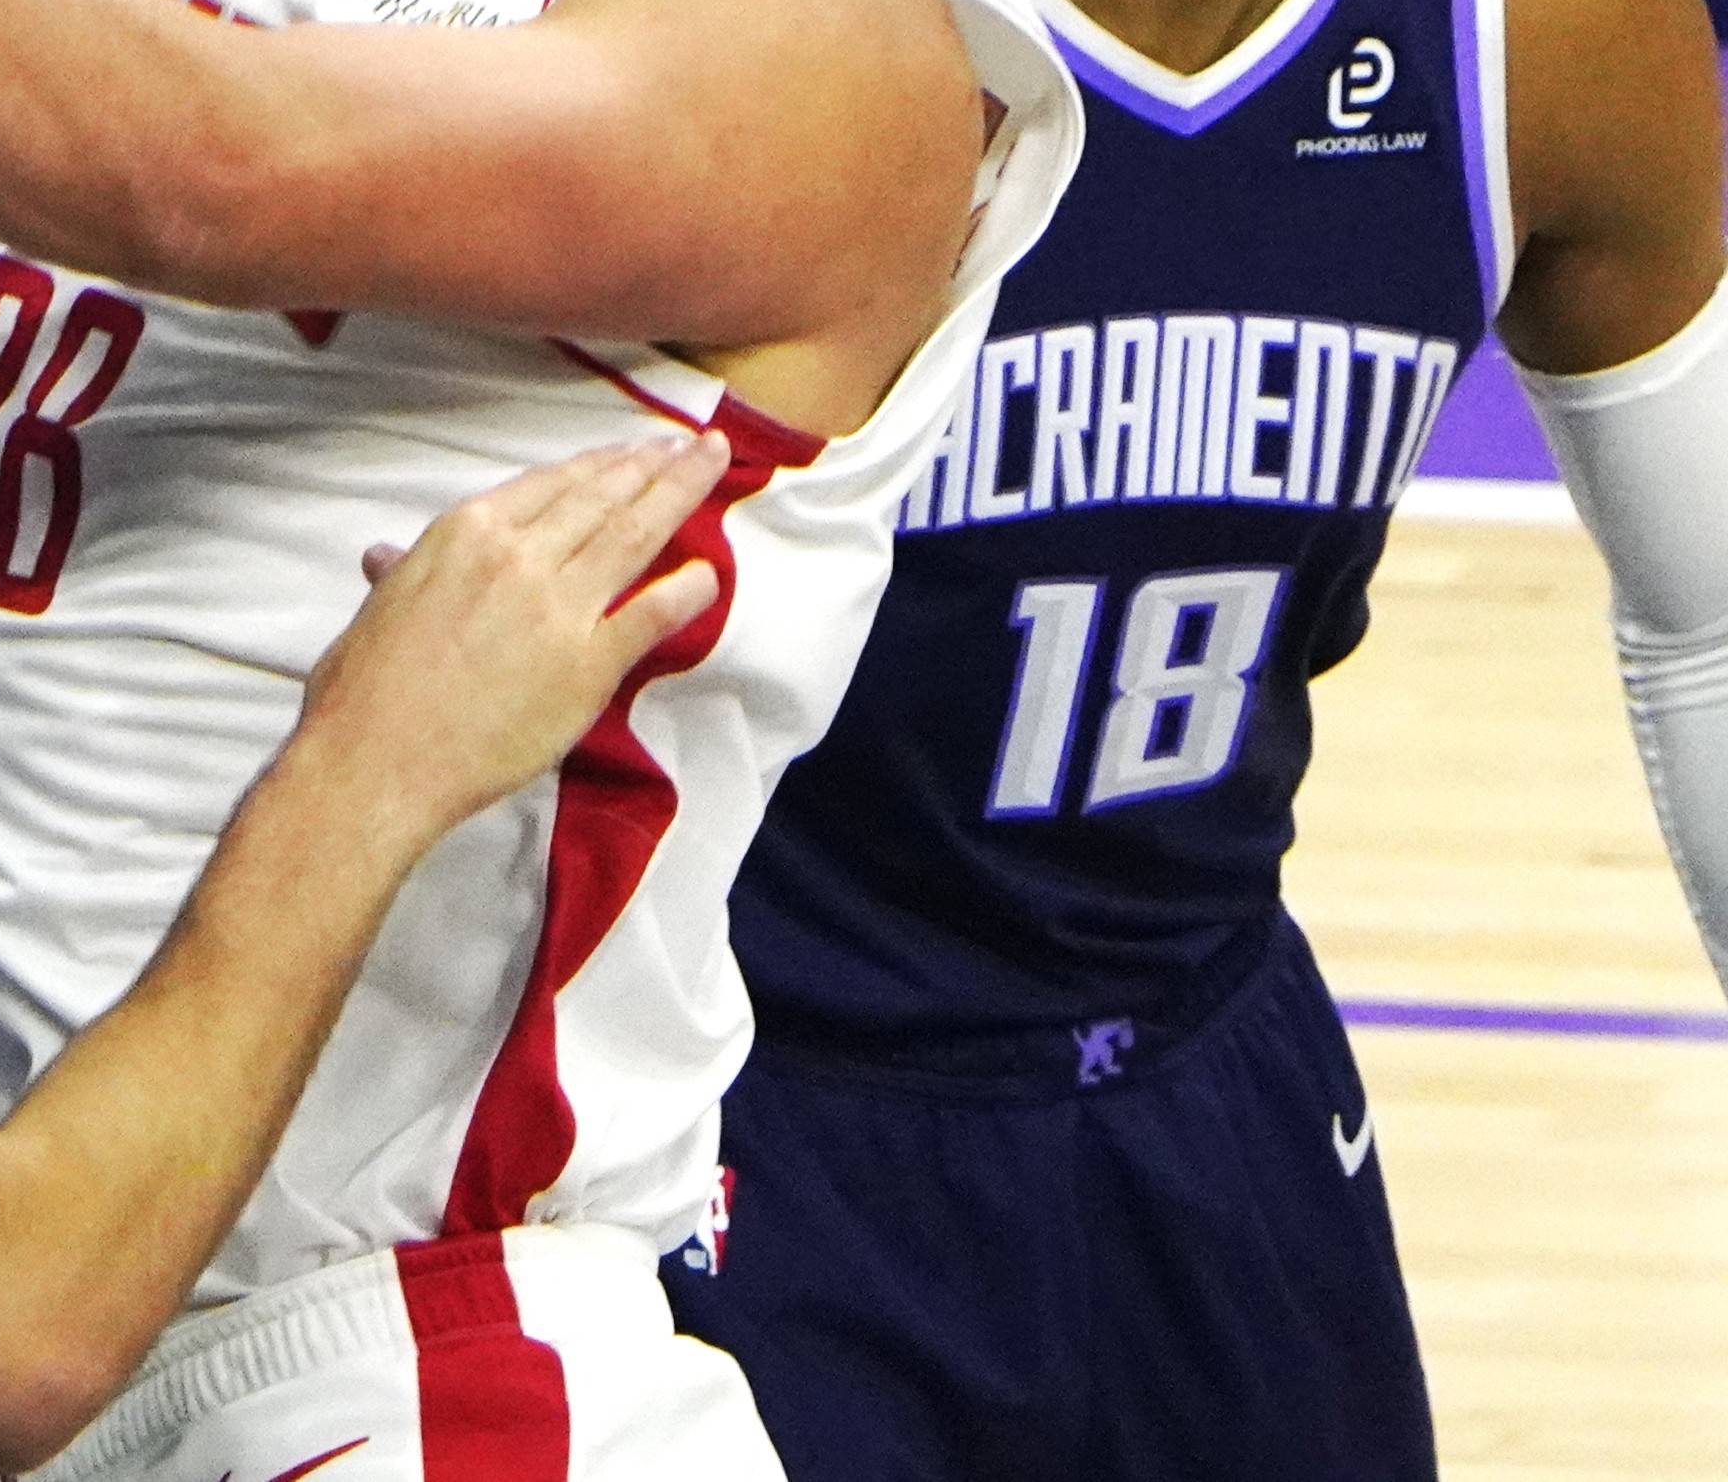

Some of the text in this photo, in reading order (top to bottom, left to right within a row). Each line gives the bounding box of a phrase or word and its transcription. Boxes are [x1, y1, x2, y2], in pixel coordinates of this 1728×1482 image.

[1295, 131, 1428, 159] PHOONG LAW
[894, 316, 1459, 534] ACRAMENTO
[986, 566, 1294, 821] 18
